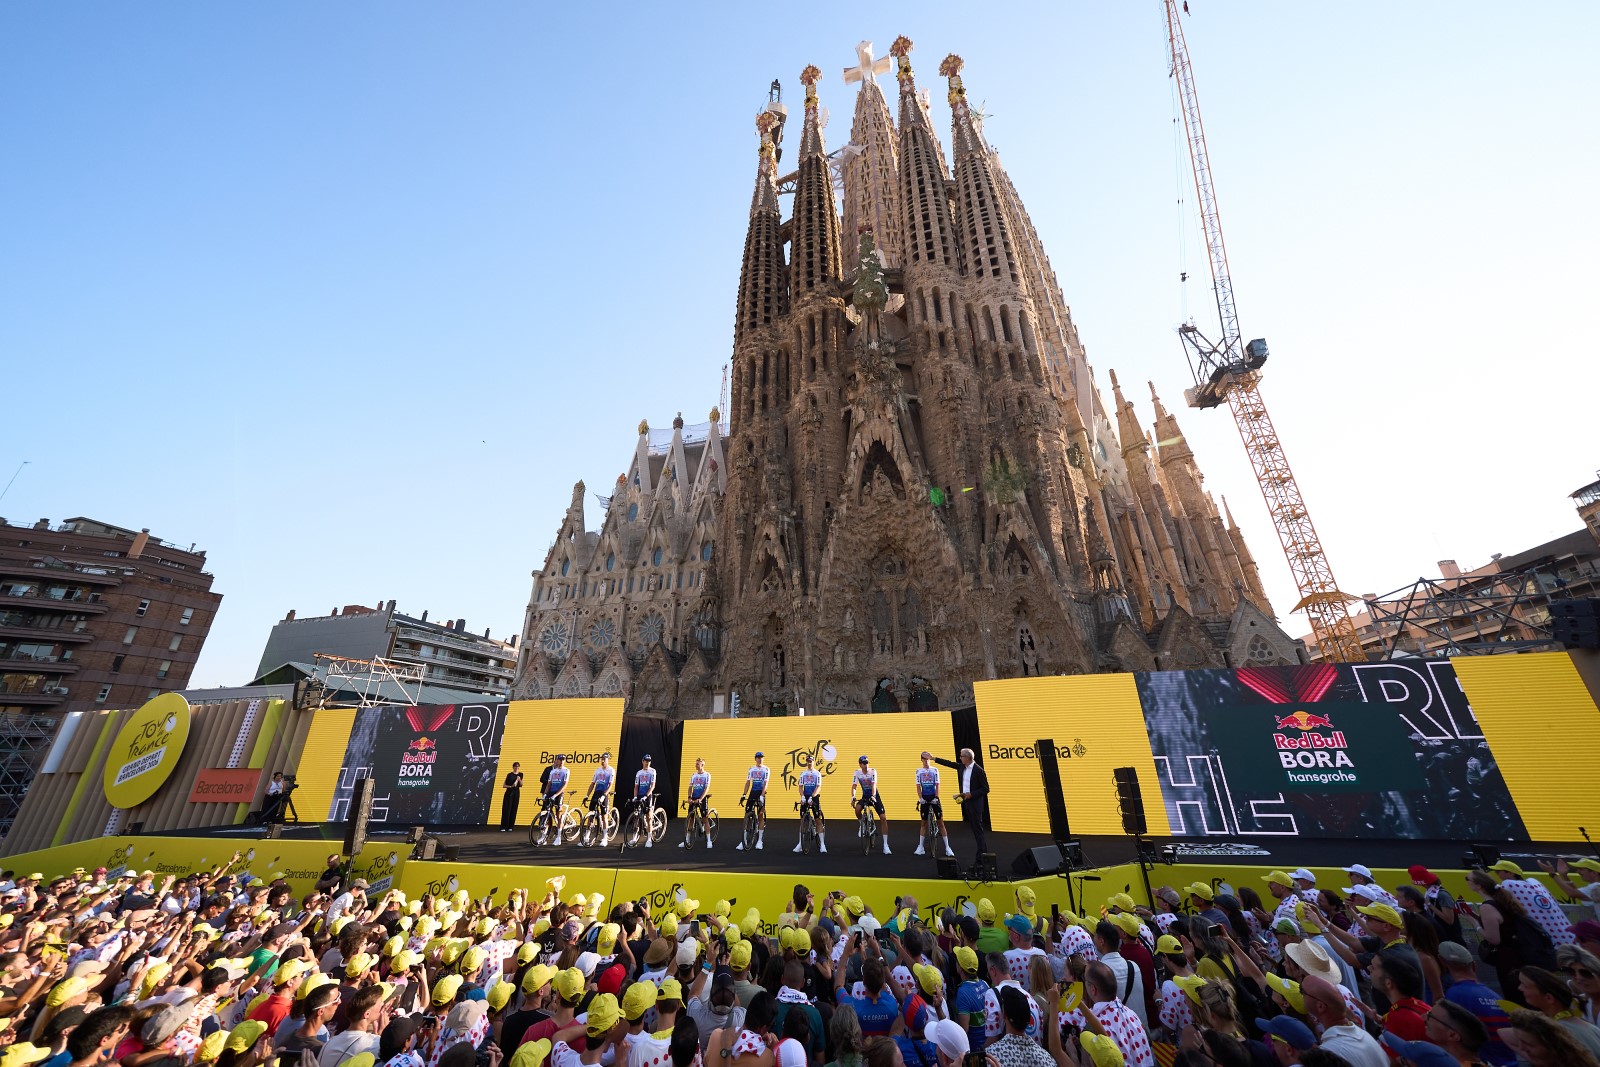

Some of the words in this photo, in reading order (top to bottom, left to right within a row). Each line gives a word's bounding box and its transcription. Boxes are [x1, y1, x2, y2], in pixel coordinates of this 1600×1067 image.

[141, 711, 176, 740] TOUR
[128, 732, 172, 759] france
[989, 744, 1071, 759] Barcelna
[540, 751, 600, 763] Barelona
[1278, 751, 1355, 768] BORA
[398, 764, 432, 777] BORA
[1288, 770, 1357, 784] hansgrohe
[196, 781, 243, 794] Barcelona
[398, 778, 430, 788] hansgrohe
[156, 863, 186, 873] Barcelona
[285, 868, 318, 879] Barcelona
[426, 874, 456, 896] TOUR
[646, 883, 683, 910] TOUR
